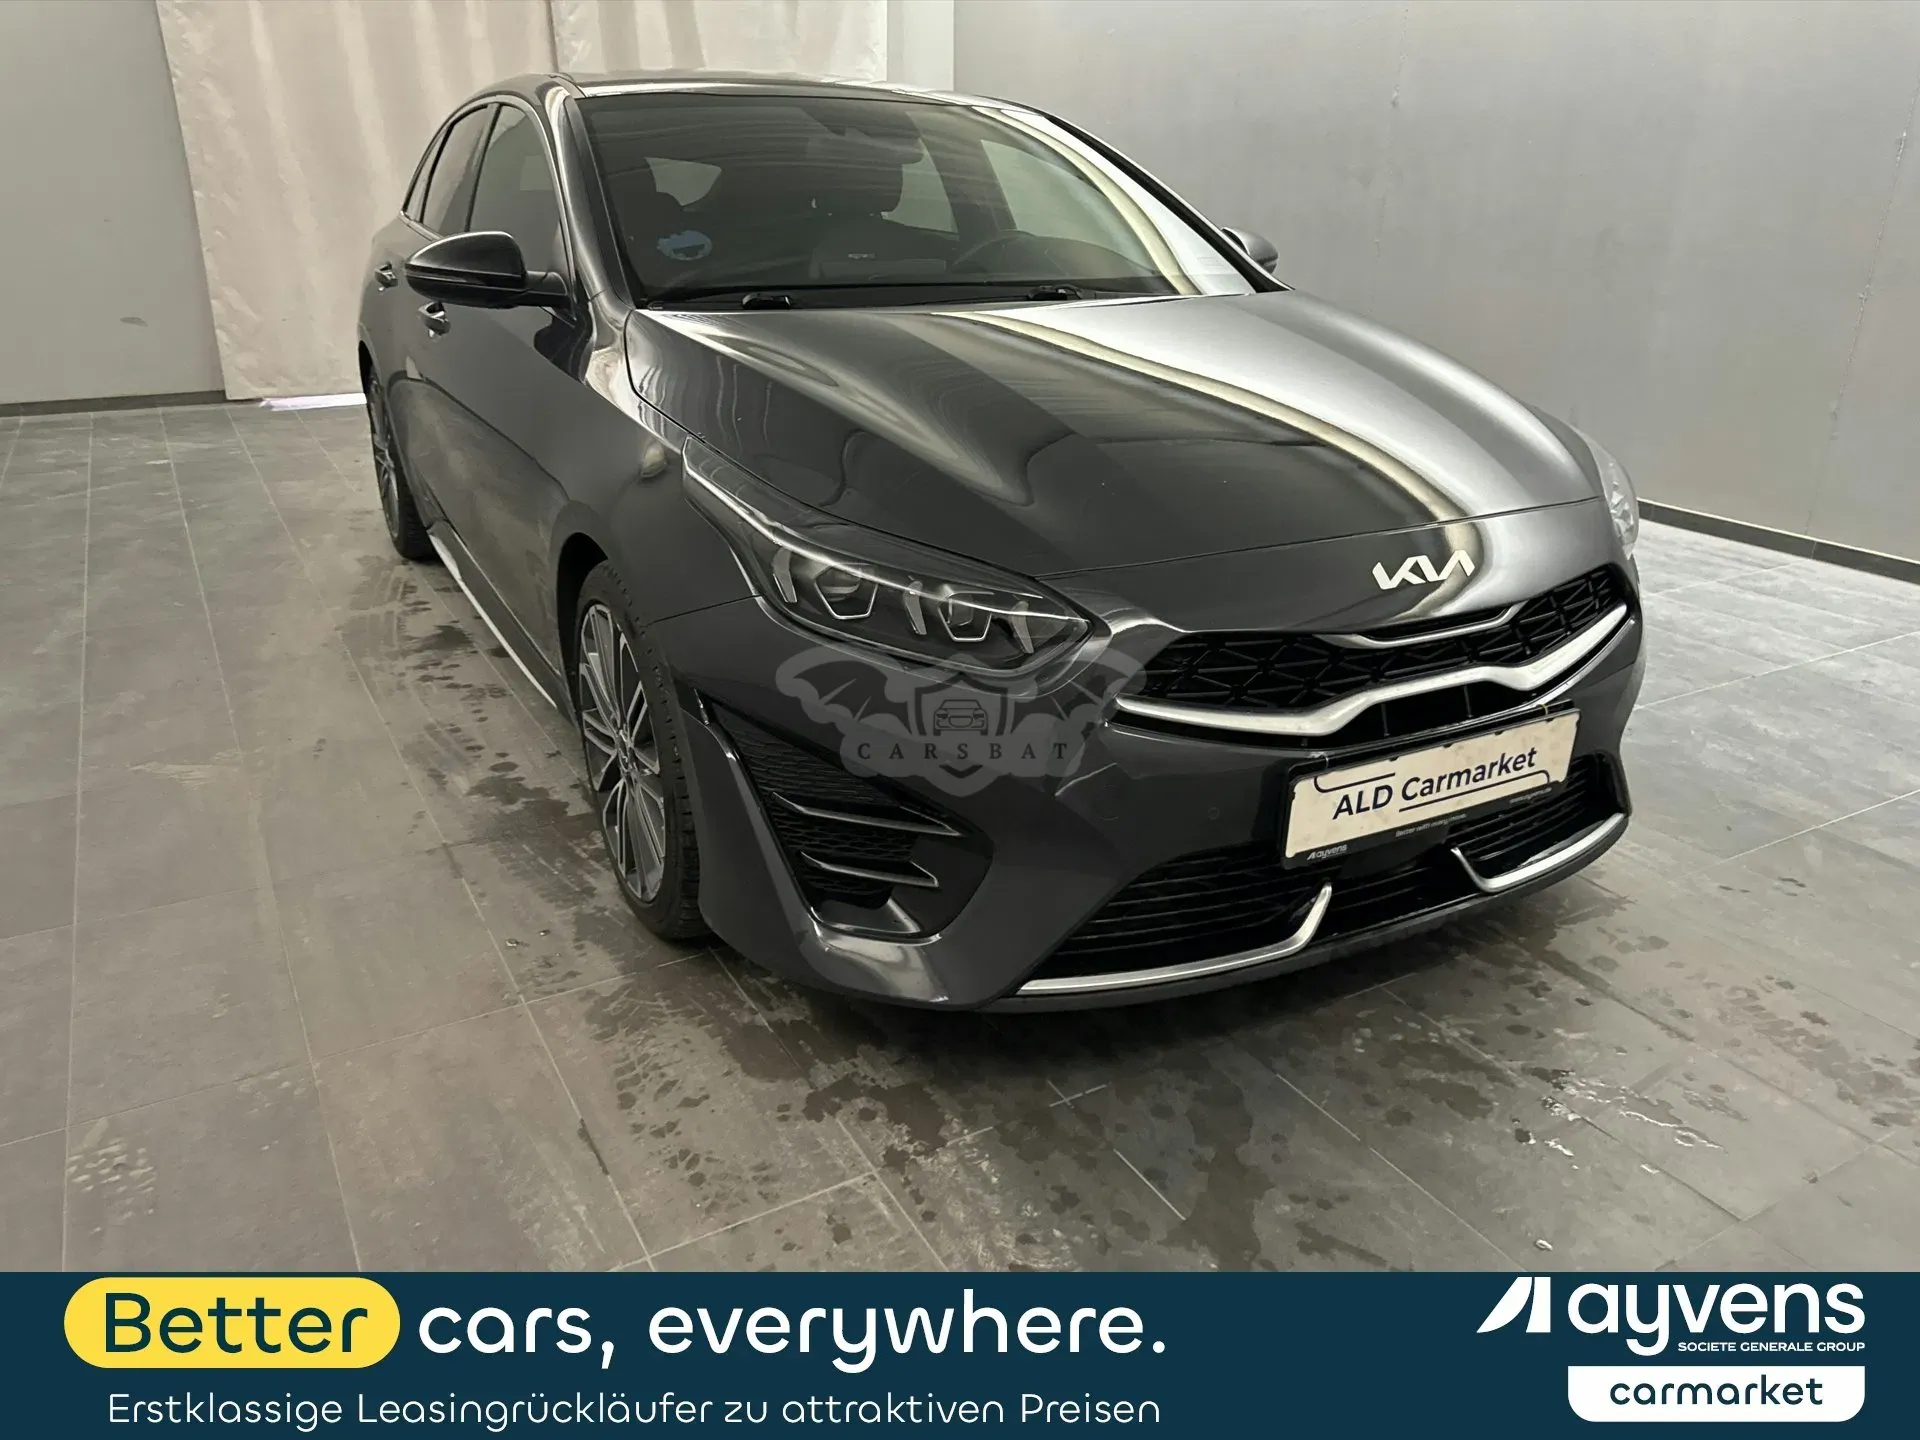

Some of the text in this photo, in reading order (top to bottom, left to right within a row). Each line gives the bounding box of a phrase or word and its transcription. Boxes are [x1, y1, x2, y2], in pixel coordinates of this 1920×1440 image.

[1371, 549, 1476, 591] KIA
[1332, 746, 1538, 820] ALD Carmarket
